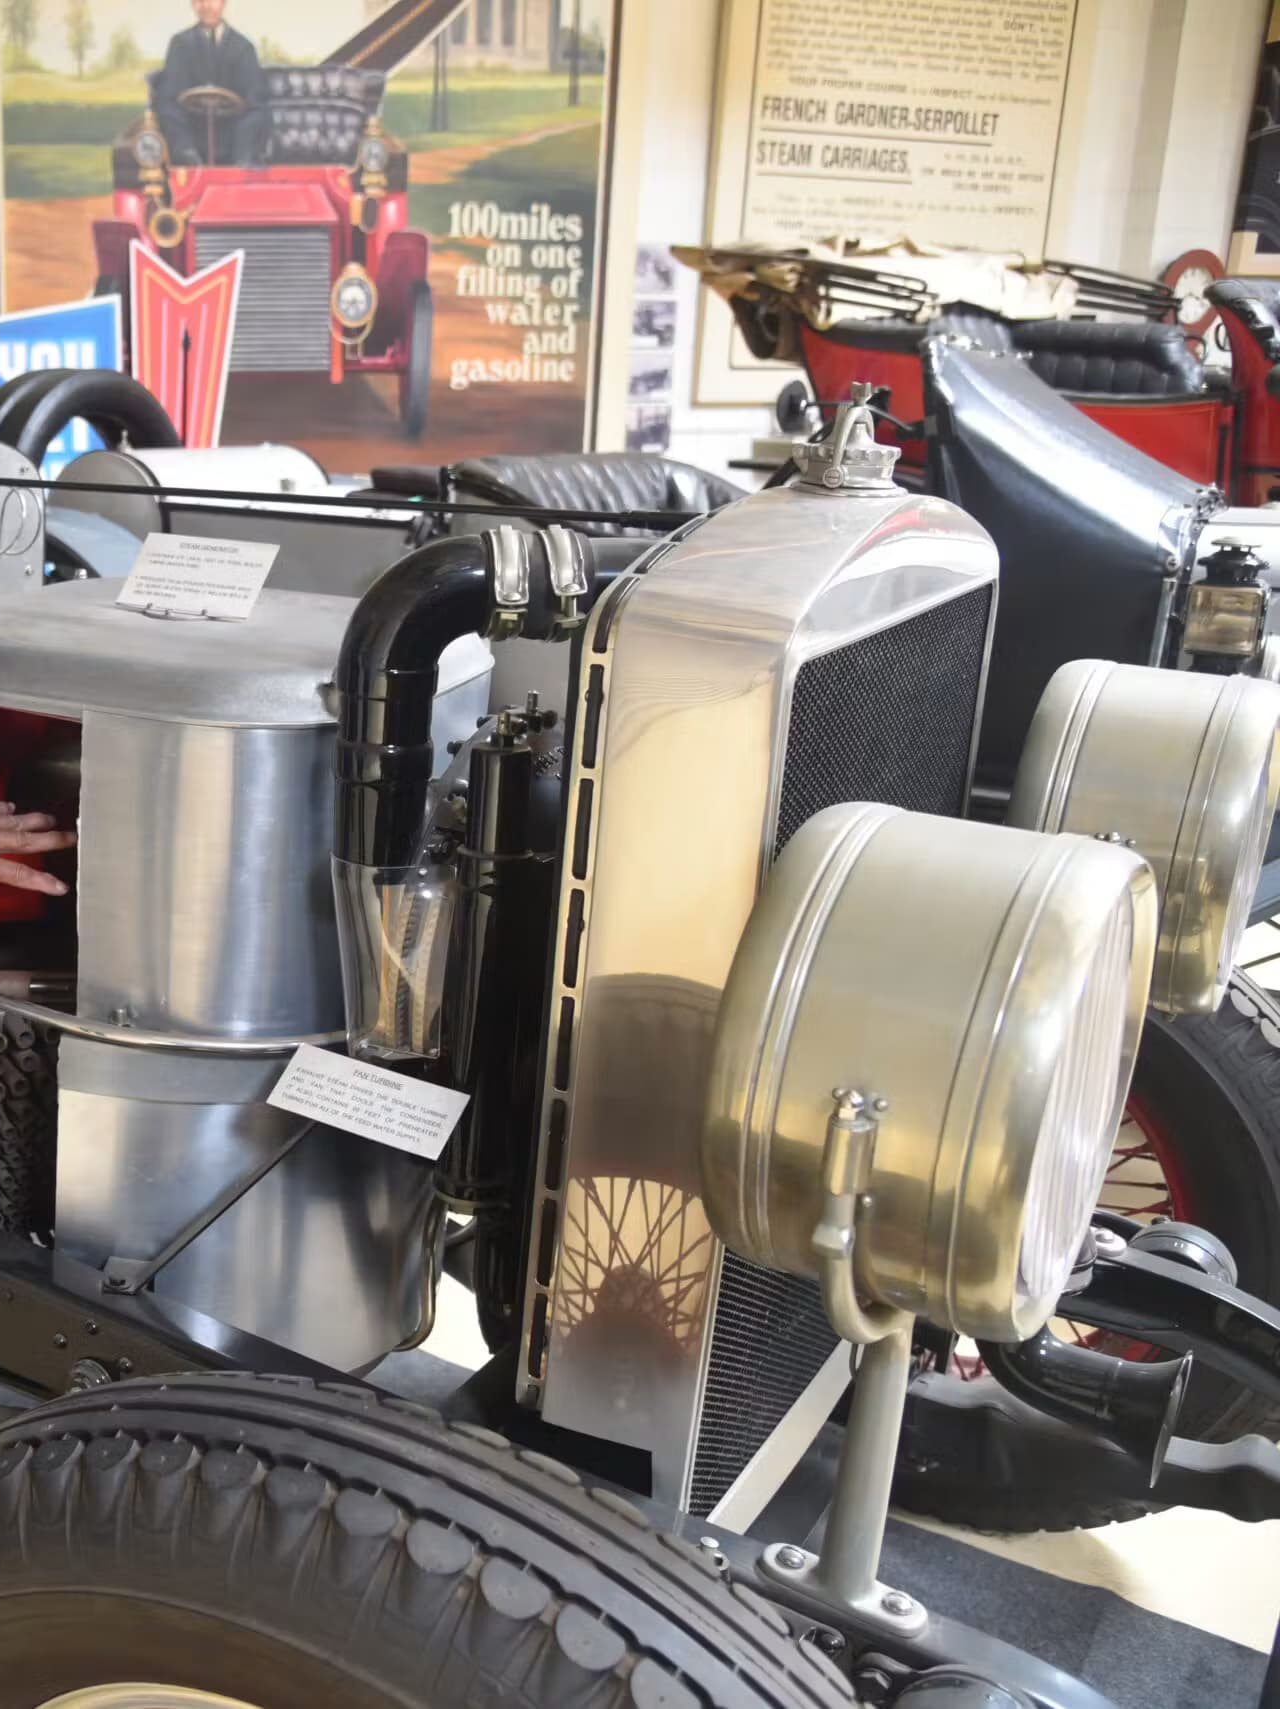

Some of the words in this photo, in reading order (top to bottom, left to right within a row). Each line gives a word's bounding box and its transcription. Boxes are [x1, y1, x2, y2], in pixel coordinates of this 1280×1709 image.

[761, 96, 828, 123] FRENCH
[835, 101, 1000, 136] GARDNER-SERPOLLET
[756, 141, 813, 168] STEAM
[821, 144, 912, 174] CARRIAGES.
[485, 243, 522, 268] on
[531, 243, 583, 269] one
[456, 264, 542, 305] filling
[550, 267, 584, 299] of
[485, 293, 580, 326] water
[522, 320, 577, 355] and
[449, 355, 576, 391] gasoline
[354, 1069, 369, 1080] FAN
